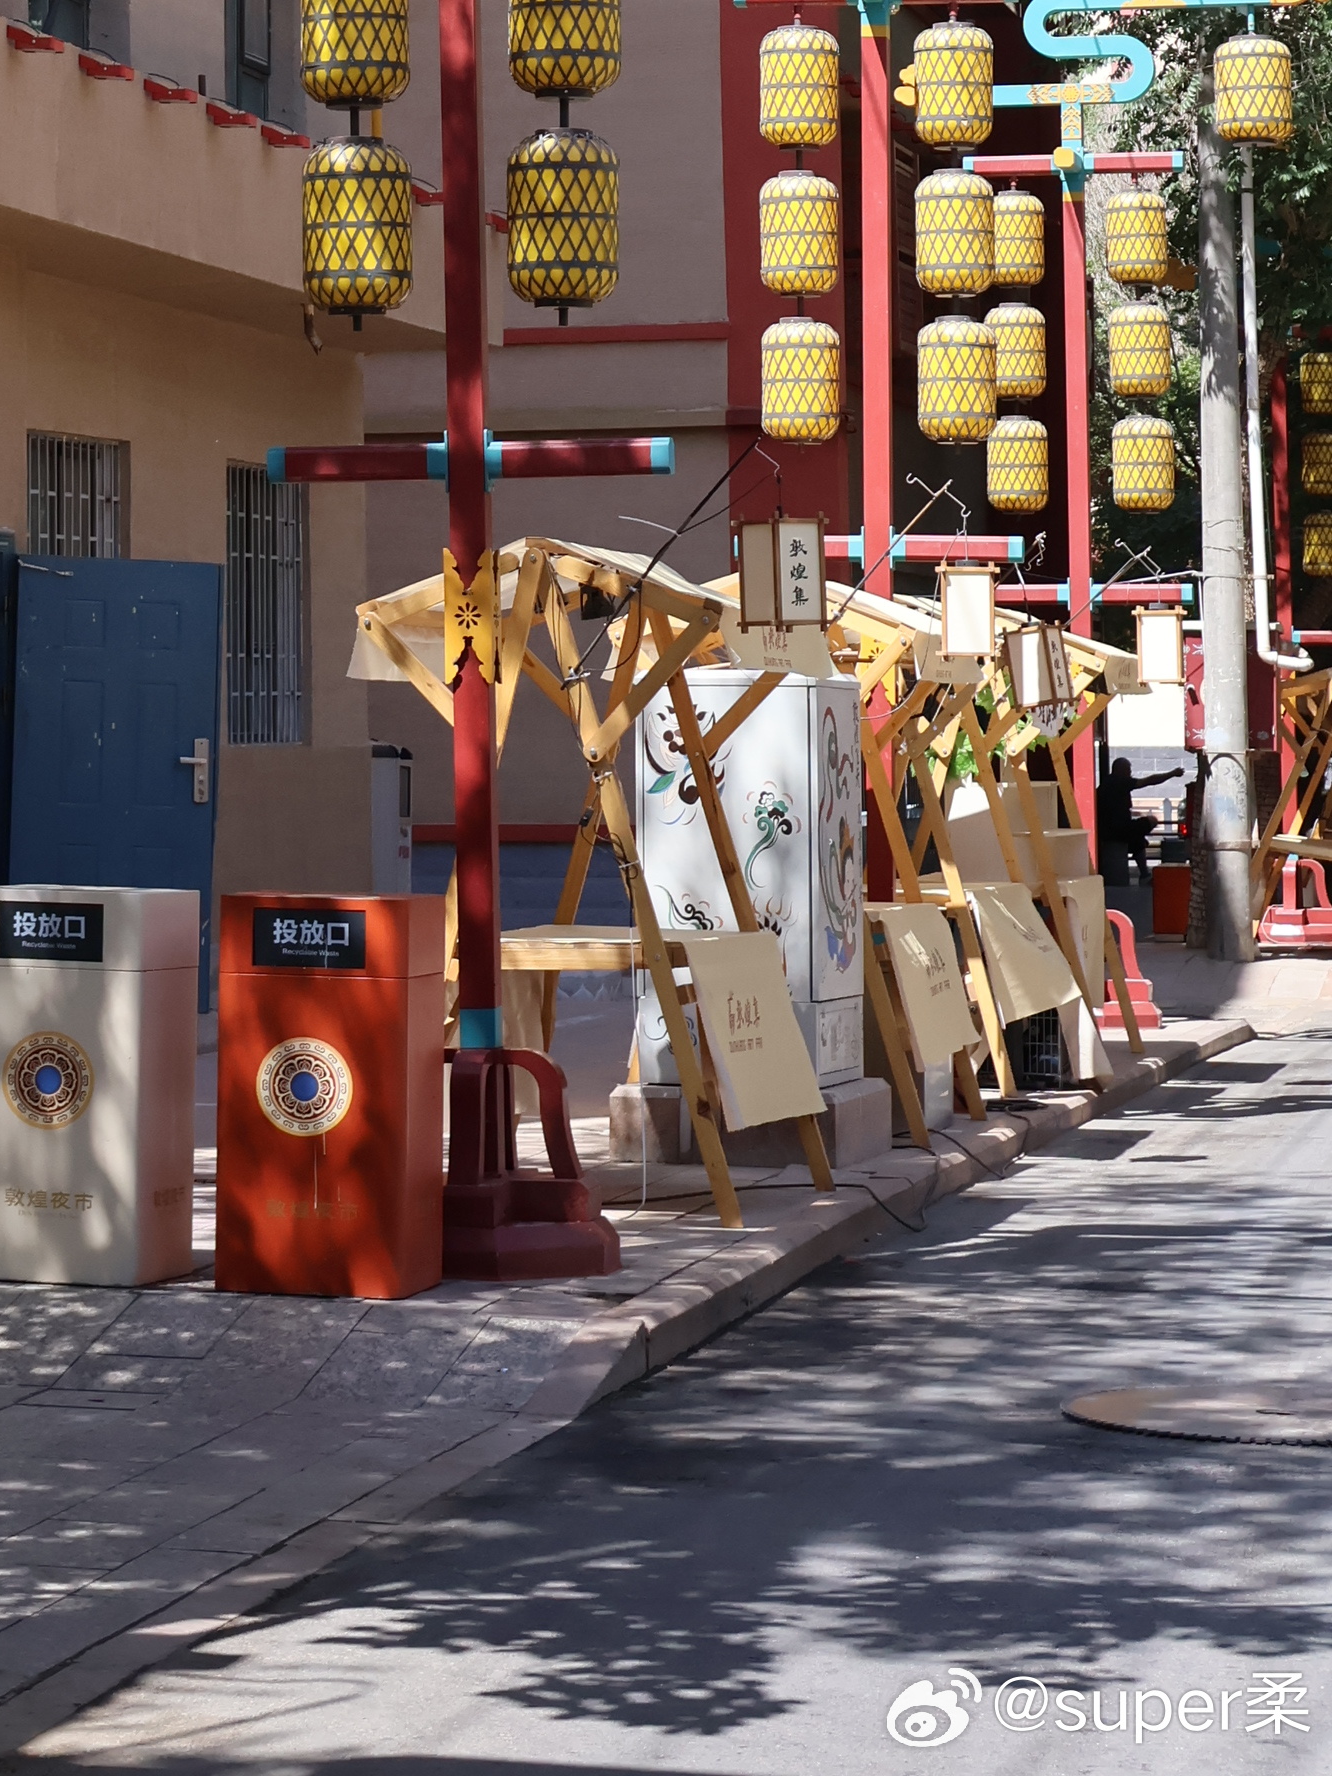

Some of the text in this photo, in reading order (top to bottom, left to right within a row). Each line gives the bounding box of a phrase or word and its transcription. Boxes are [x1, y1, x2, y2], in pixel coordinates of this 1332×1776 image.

[789, 538, 810, 607] 敦煌集
[12, 911, 86, 940] 投放口
[272, 917, 350, 947] 投放口
[3, 1187, 95, 1212] 敦煌夜市
